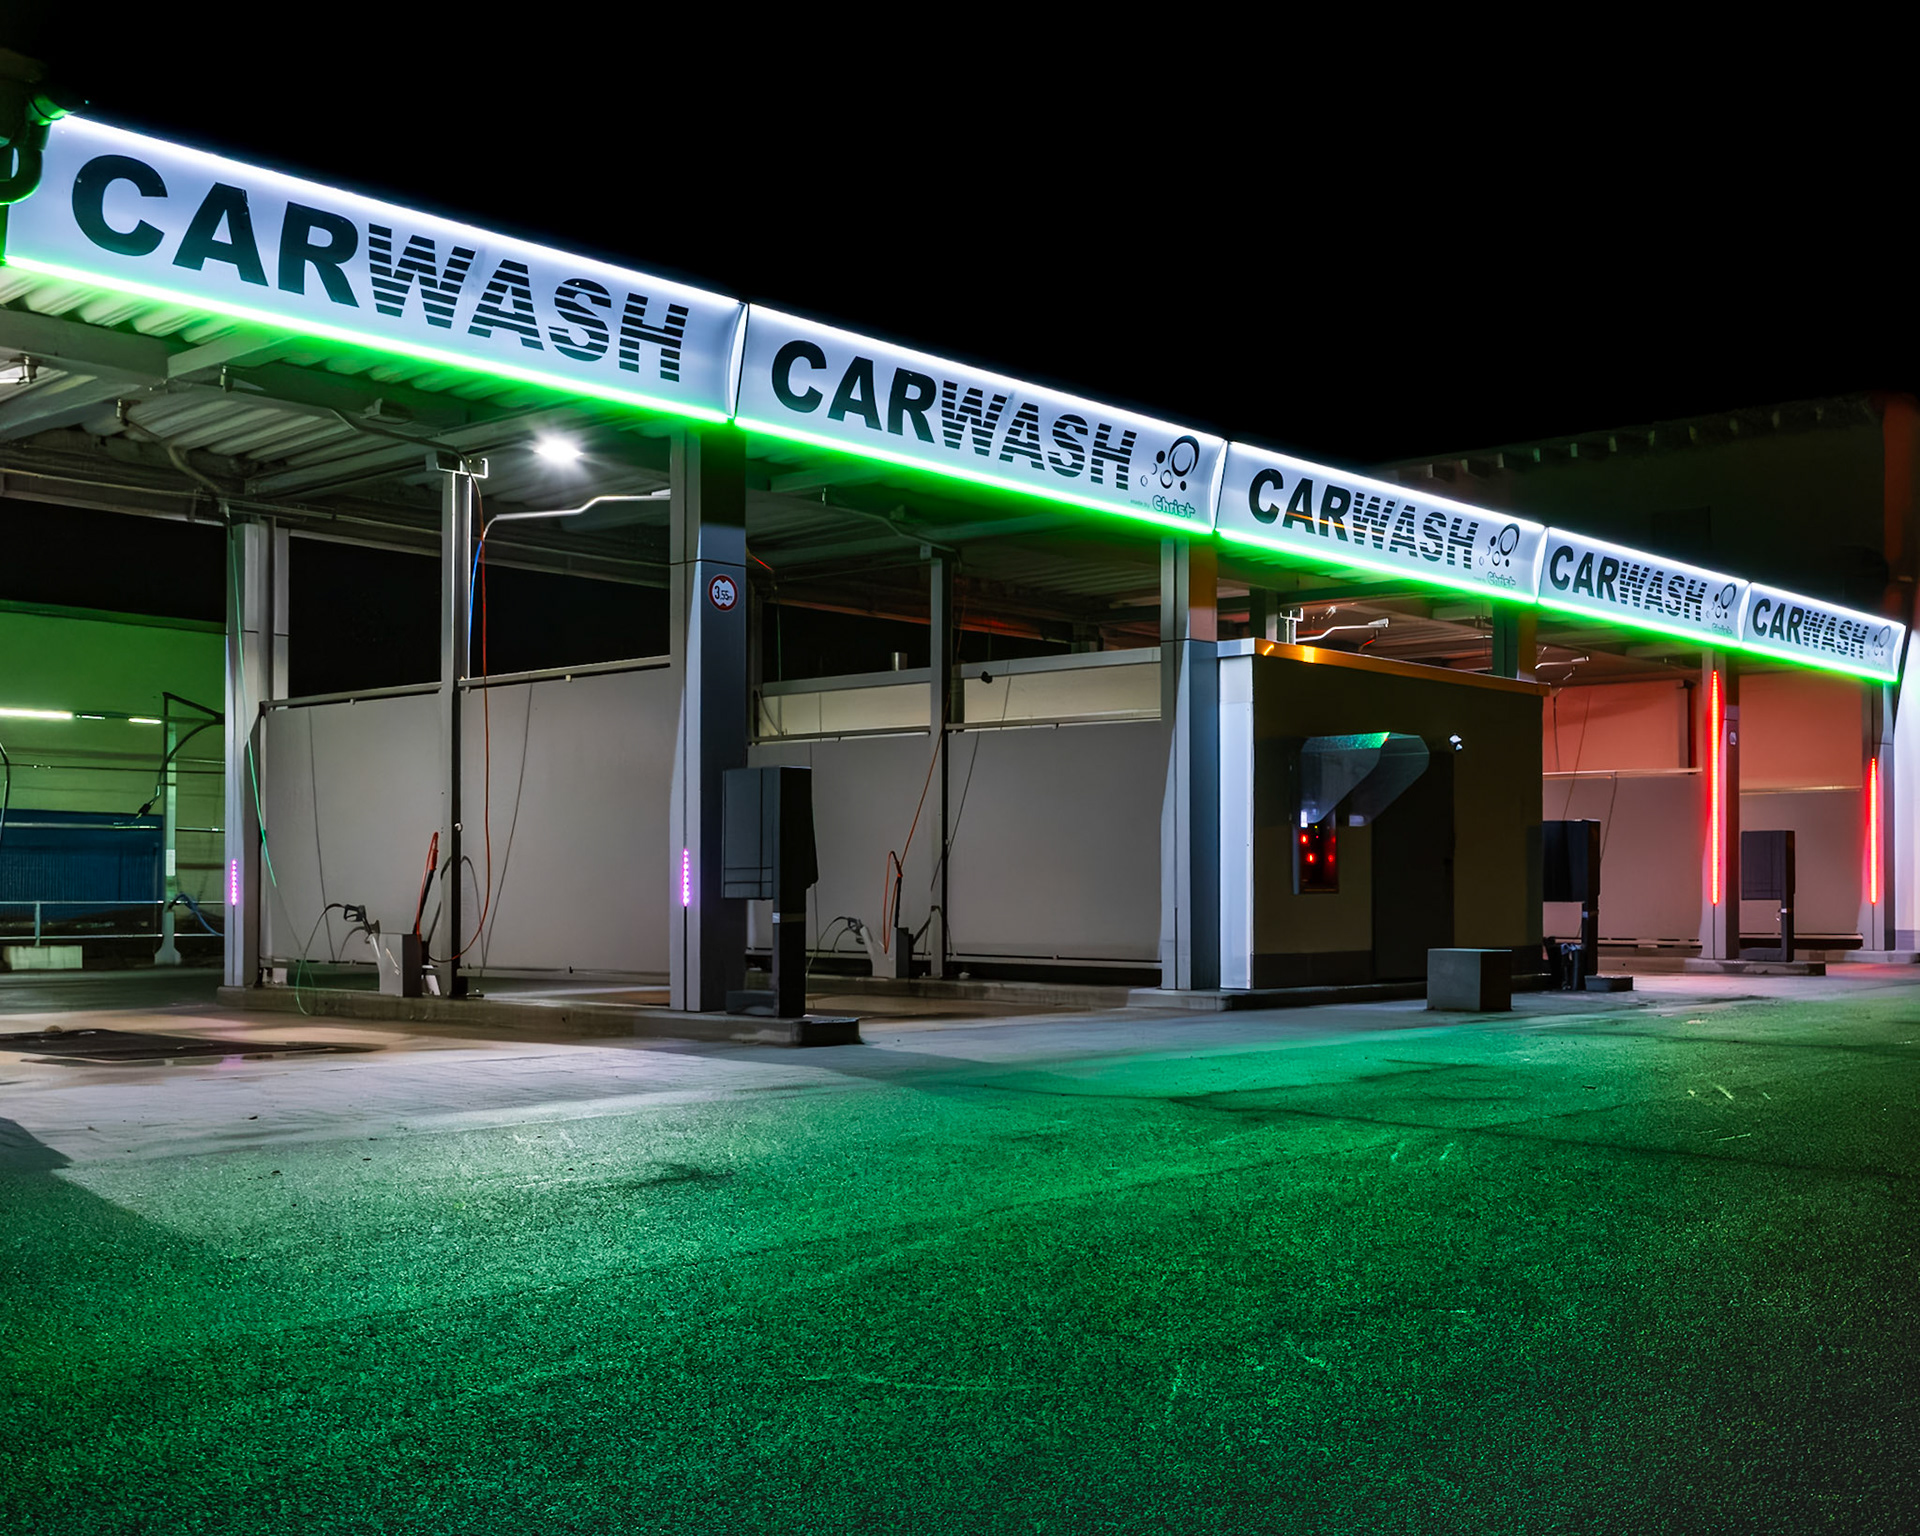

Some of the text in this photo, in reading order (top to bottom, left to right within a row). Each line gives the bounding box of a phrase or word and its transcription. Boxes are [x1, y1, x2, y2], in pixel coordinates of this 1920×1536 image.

[72, 154, 689, 383] CARWASH
[772, 340, 1137, 491] CARWASH
[1152, 494, 1196, 518] Christ
[1249, 468, 1479, 569] CARWASH
[1549, 546, 1708, 622] CARWASH
[1752, 598, 1869, 659] CARWASH
